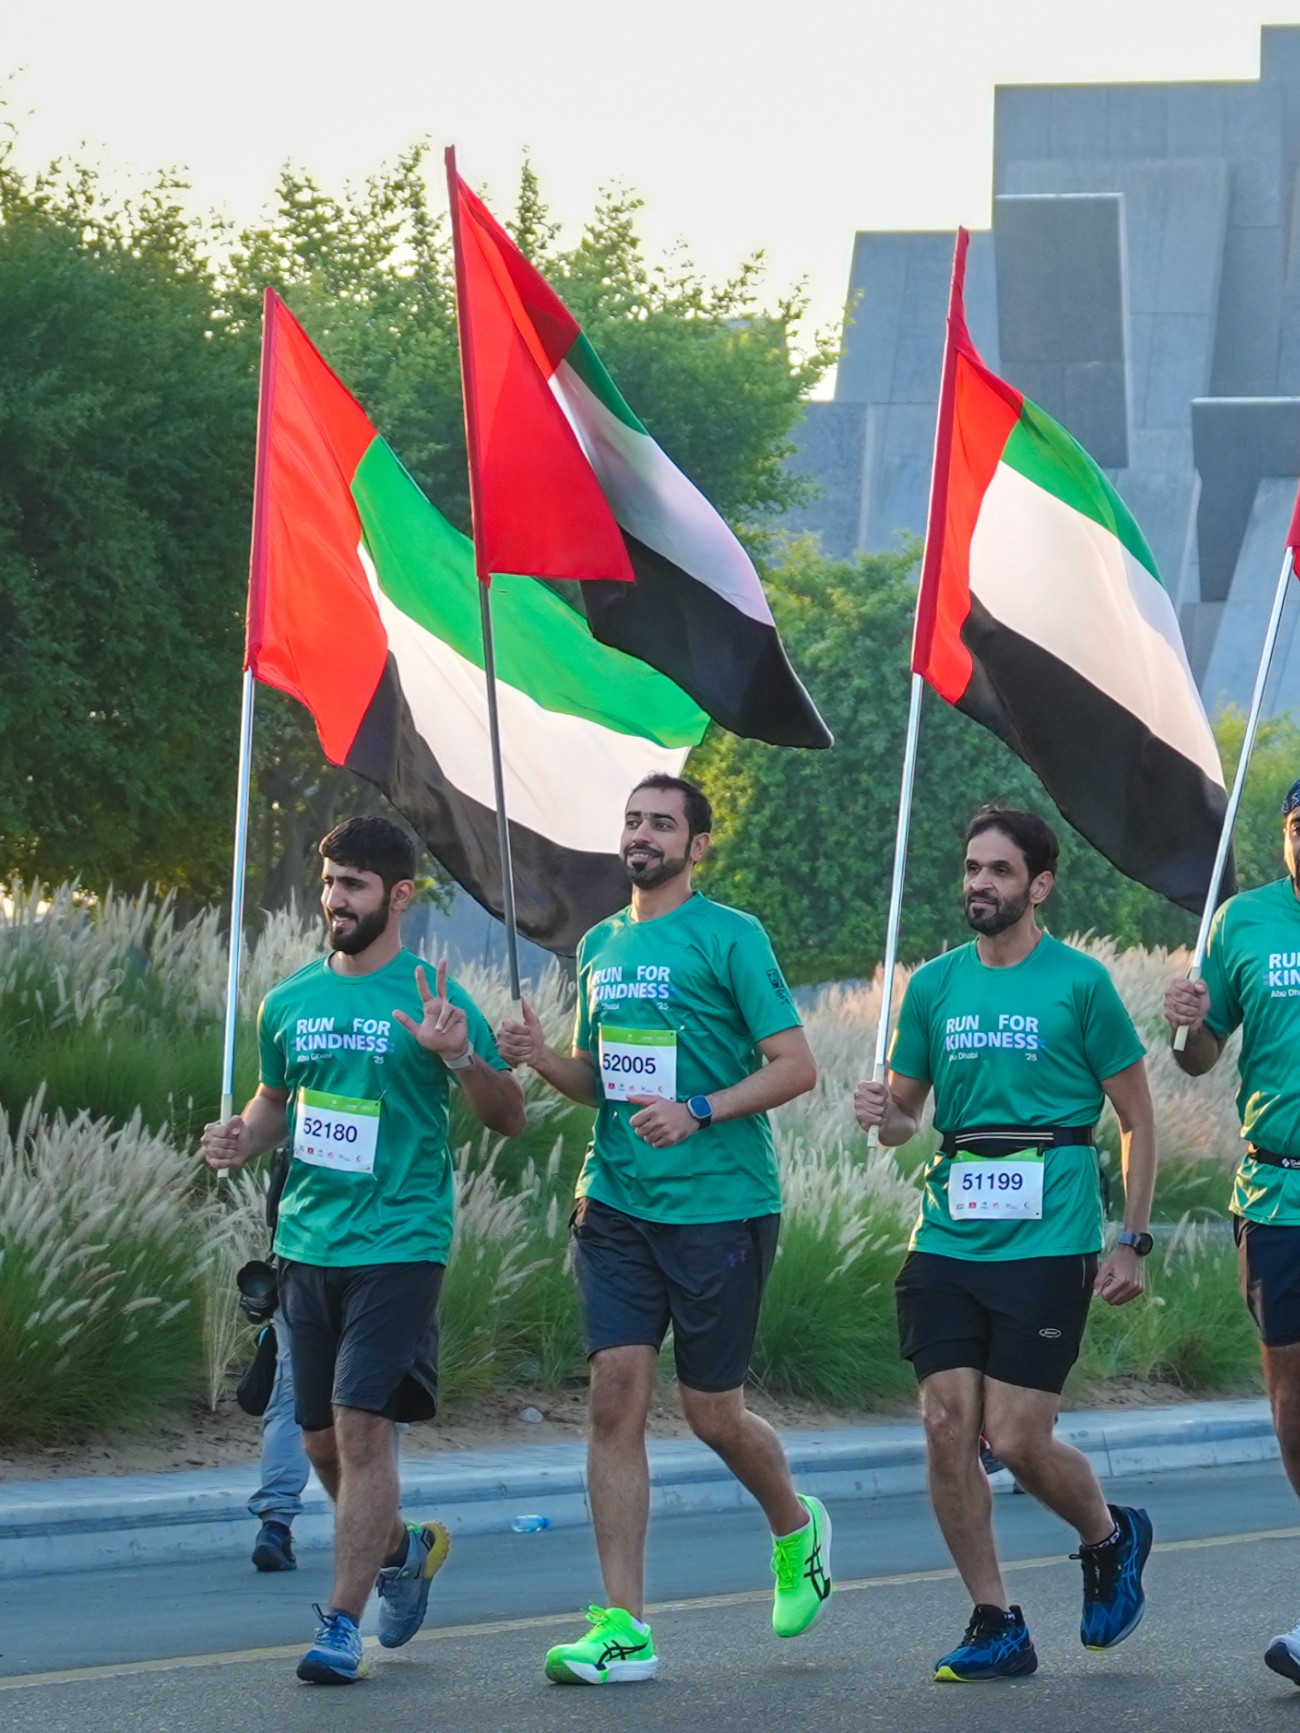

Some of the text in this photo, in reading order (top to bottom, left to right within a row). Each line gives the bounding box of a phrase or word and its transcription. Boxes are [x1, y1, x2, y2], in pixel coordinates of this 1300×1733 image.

[637, 965, 670, 982] FOR
[1271, 990, 1286, 998] Abu
[296, 1017, 391, 1036] RUN FOR
[946, 1014, 1039, 1034] RUN FOR
[295, 1033, 389, 1053] KINDNESS
[945, 1032, 1039, 1051] KINDNESS
[602, 1053, 656, 1075] 52005
[303, 1117, 358, 1143] 52180
[962, 1172, 1023, 1190] 51199
